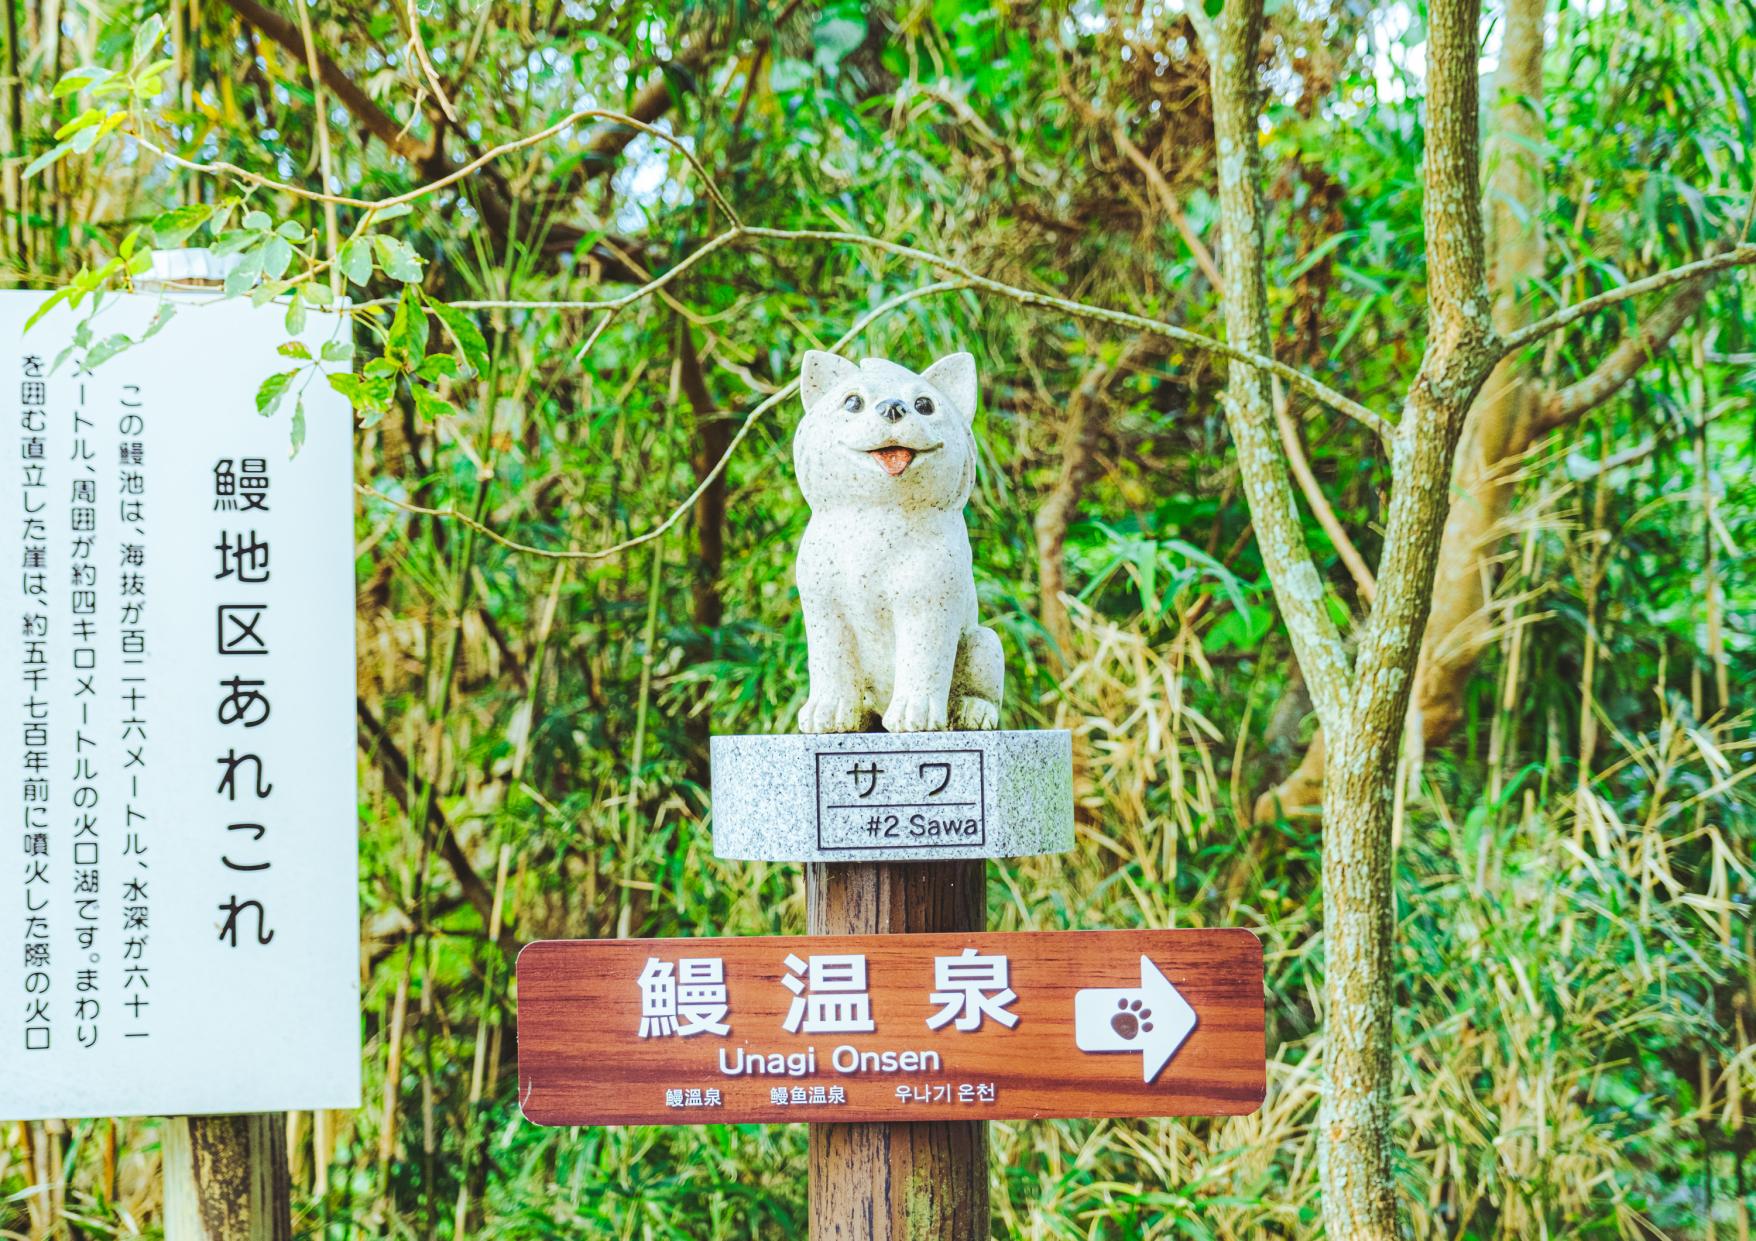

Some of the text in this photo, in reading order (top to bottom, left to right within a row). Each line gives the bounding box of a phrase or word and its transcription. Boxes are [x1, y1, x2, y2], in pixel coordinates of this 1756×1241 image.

[20, 355, 52, 1051] を囲む直立した崖は、約五千七百年前に噴火した際の火口
[118, 384, 150, 1038] この鰻池は、海抜が百二十六メートル、水深が六十一
[211, 457, 275, 948] 鰻地区あれこれ
[846, 761, 952, 798] サワ
[867, 814, 979, 838] #2 Sawa
[636, 948, 1020, 1039] 鰻温泉
[718, 1045, 940, 1077] Unagi Onsen
[895, 1083, 996, 1104] 우나기 온천
